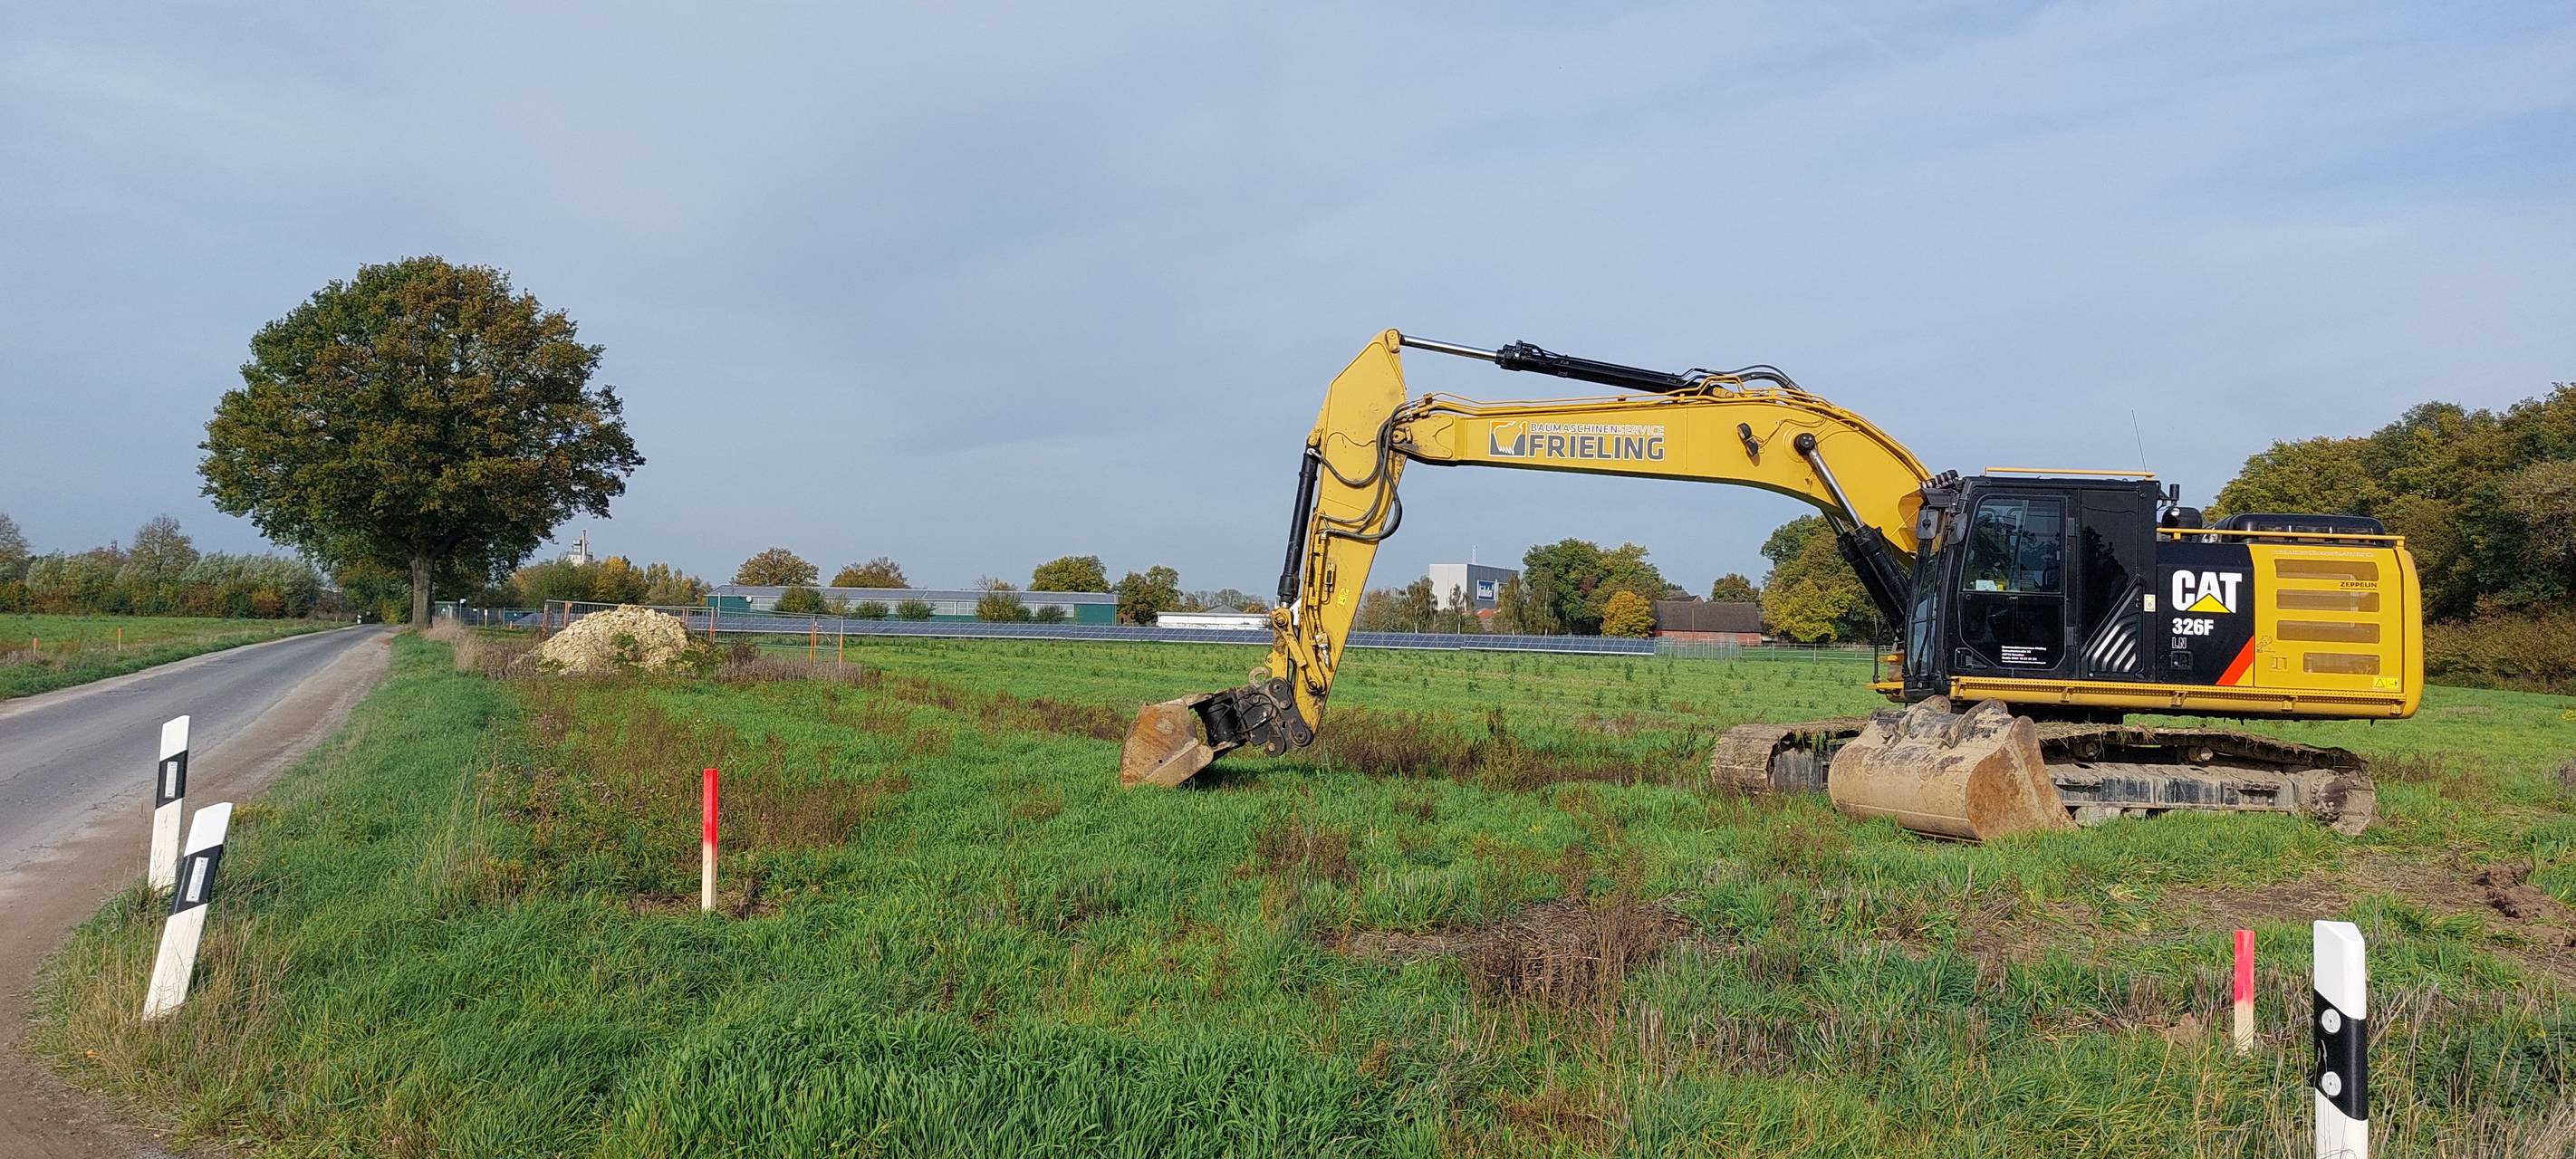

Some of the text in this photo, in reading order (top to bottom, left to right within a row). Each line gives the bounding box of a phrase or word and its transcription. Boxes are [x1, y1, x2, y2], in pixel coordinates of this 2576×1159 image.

[1528, 434, 1665, 461] FRIELING
[2172, 570, 2243, 614] CAT
[2172, 618, 2215, 636] 326F
[2171, 637, 2187, 649] LN
